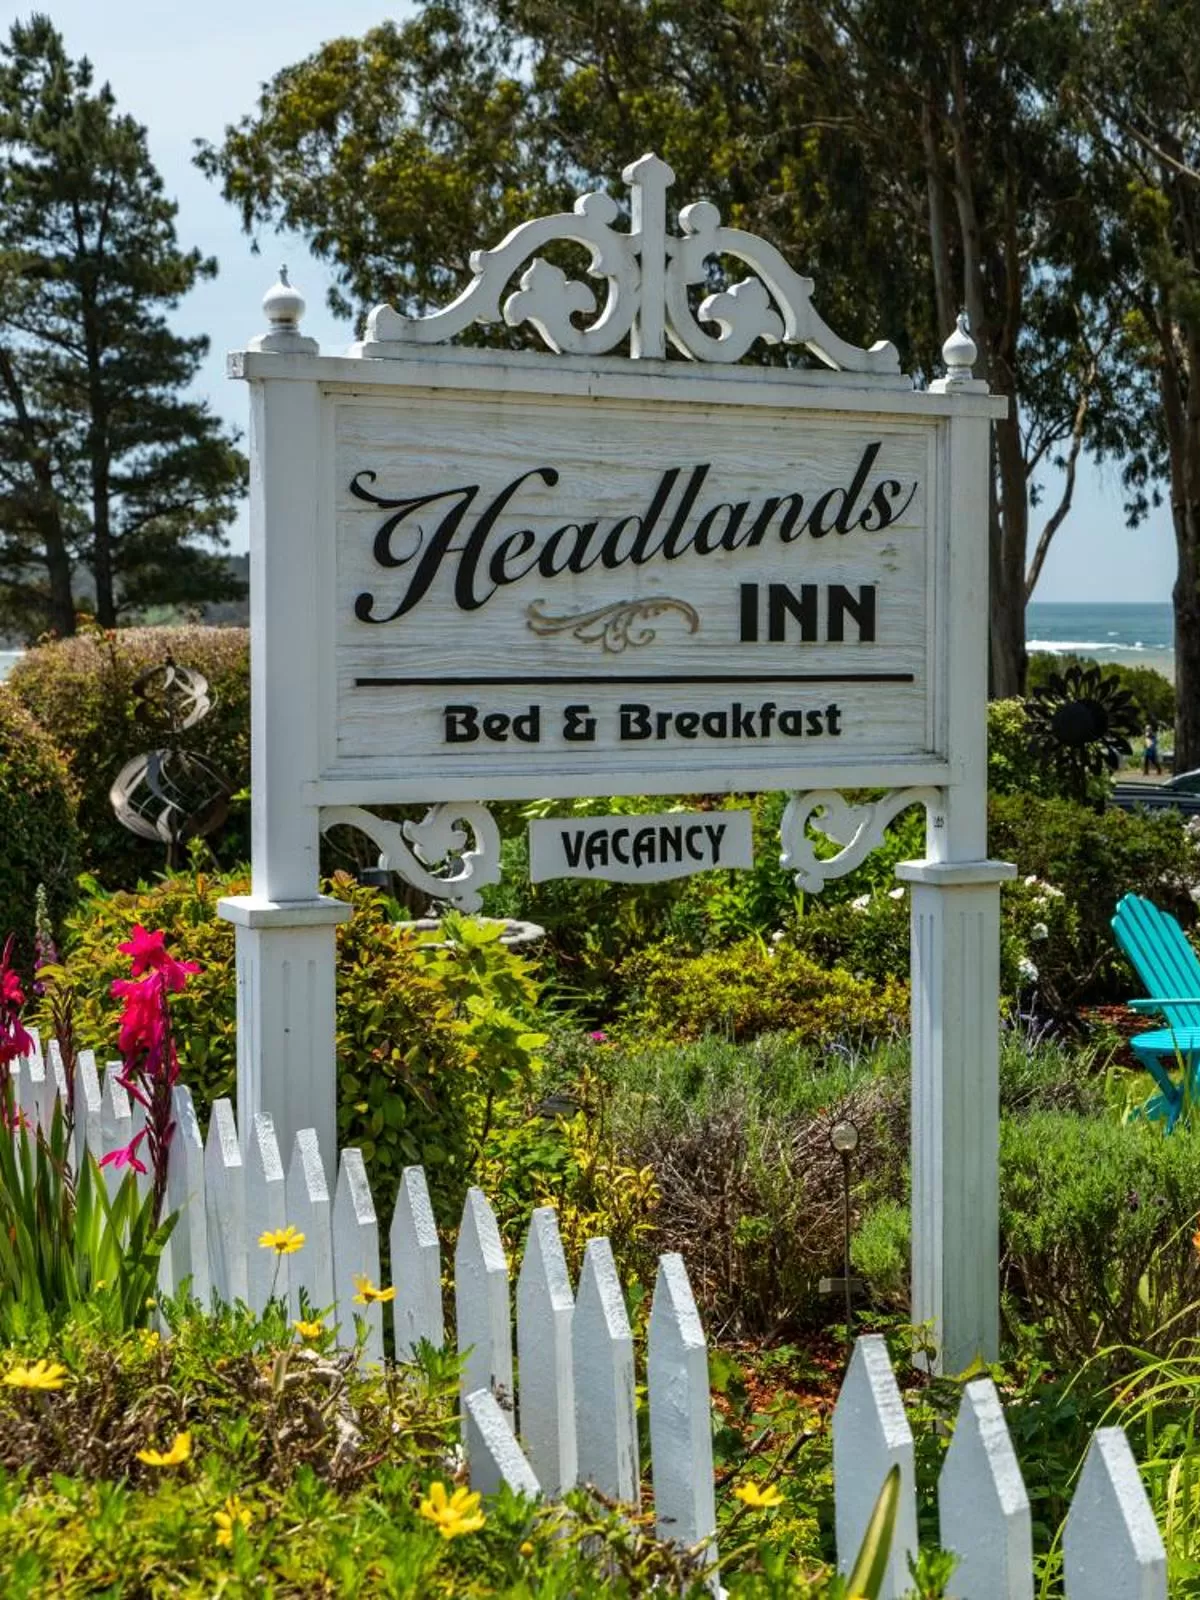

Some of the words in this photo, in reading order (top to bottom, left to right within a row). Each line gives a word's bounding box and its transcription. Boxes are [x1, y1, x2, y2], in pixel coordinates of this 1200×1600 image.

[349, 441, 918, 624] Headlands
[739, 582, 877, 644] INN
[442, 704, 541, 744] Bed
[562, 704, 598, 742] &
[617, 701, 843, 742] Breakfast
[561, 823, 727, 871] VACANCY
